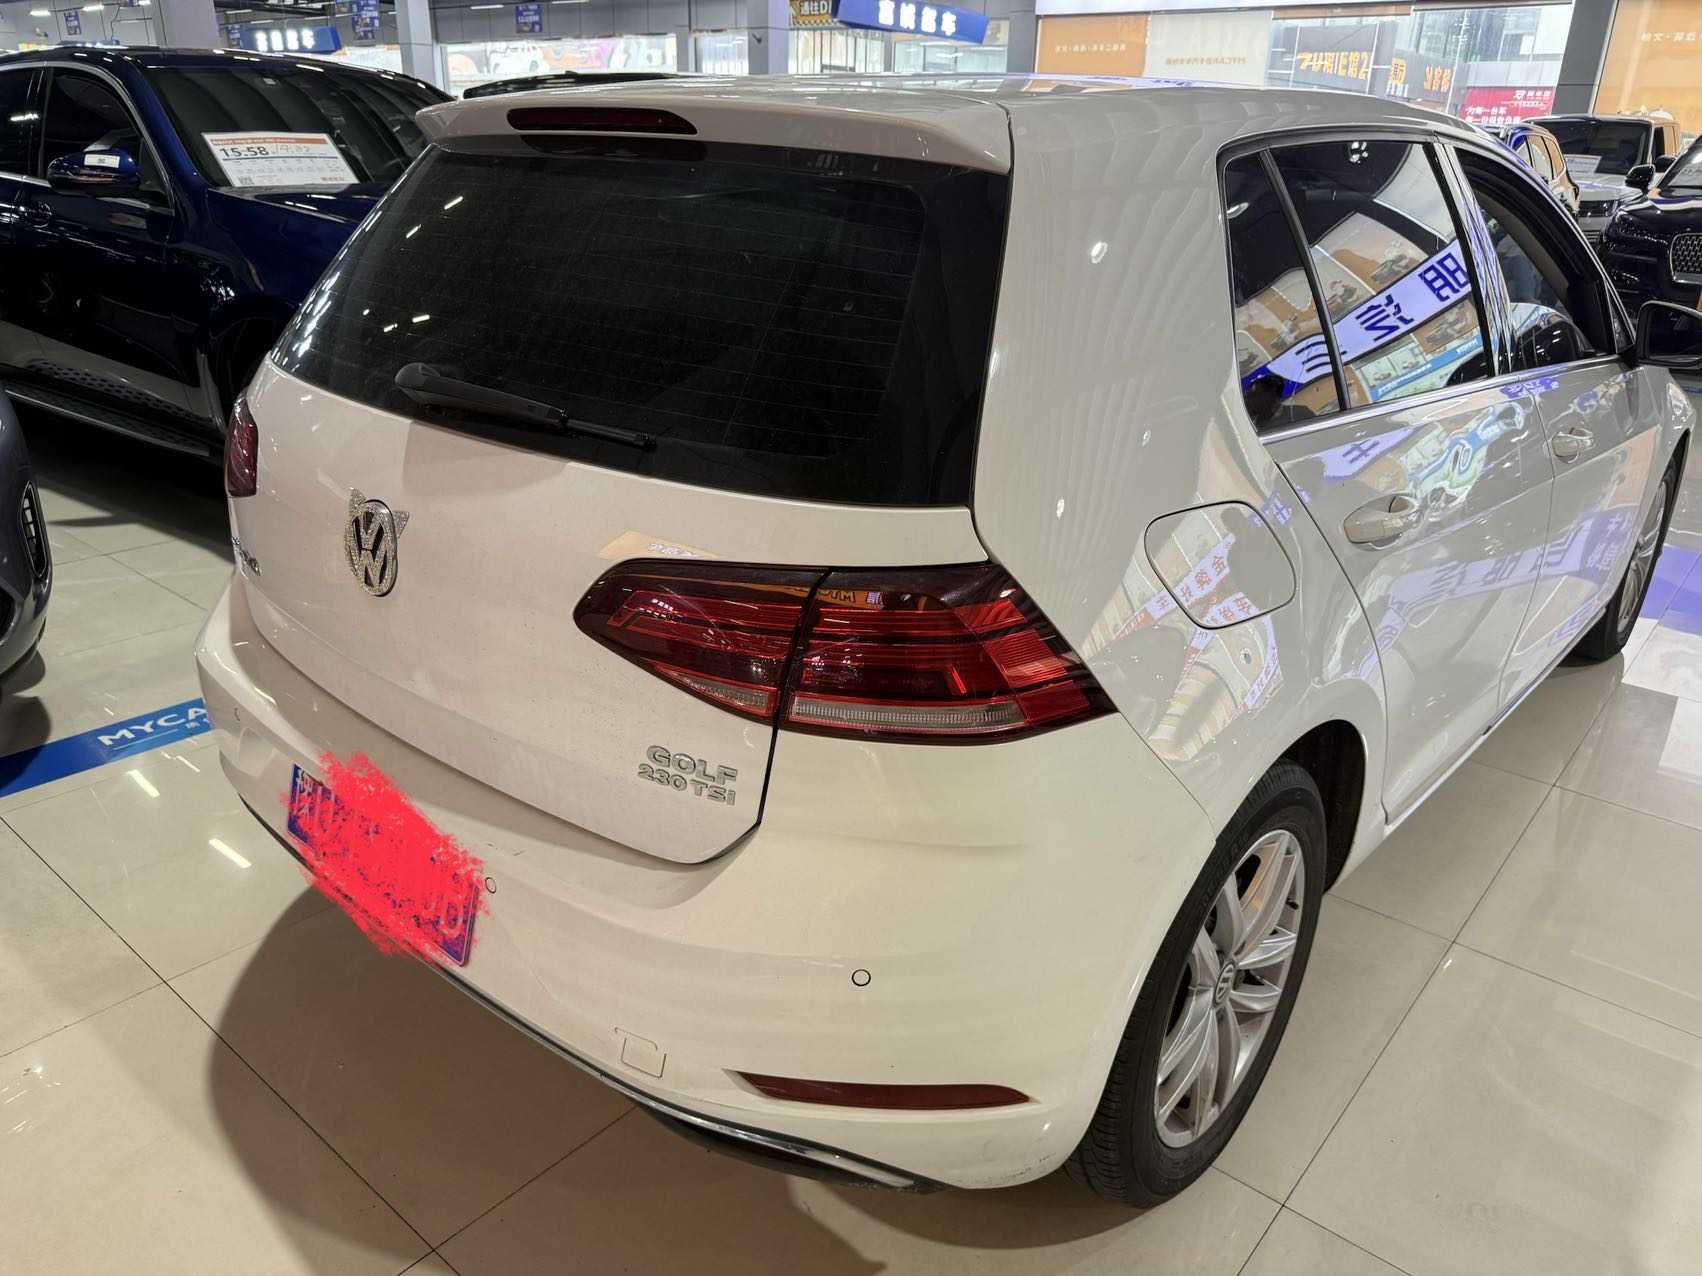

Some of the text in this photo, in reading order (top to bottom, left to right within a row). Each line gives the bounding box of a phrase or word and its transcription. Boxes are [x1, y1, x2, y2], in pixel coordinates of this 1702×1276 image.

[637, 763, 737, 806] 230 TSI
[646, 745, 739, 785] GOLF
